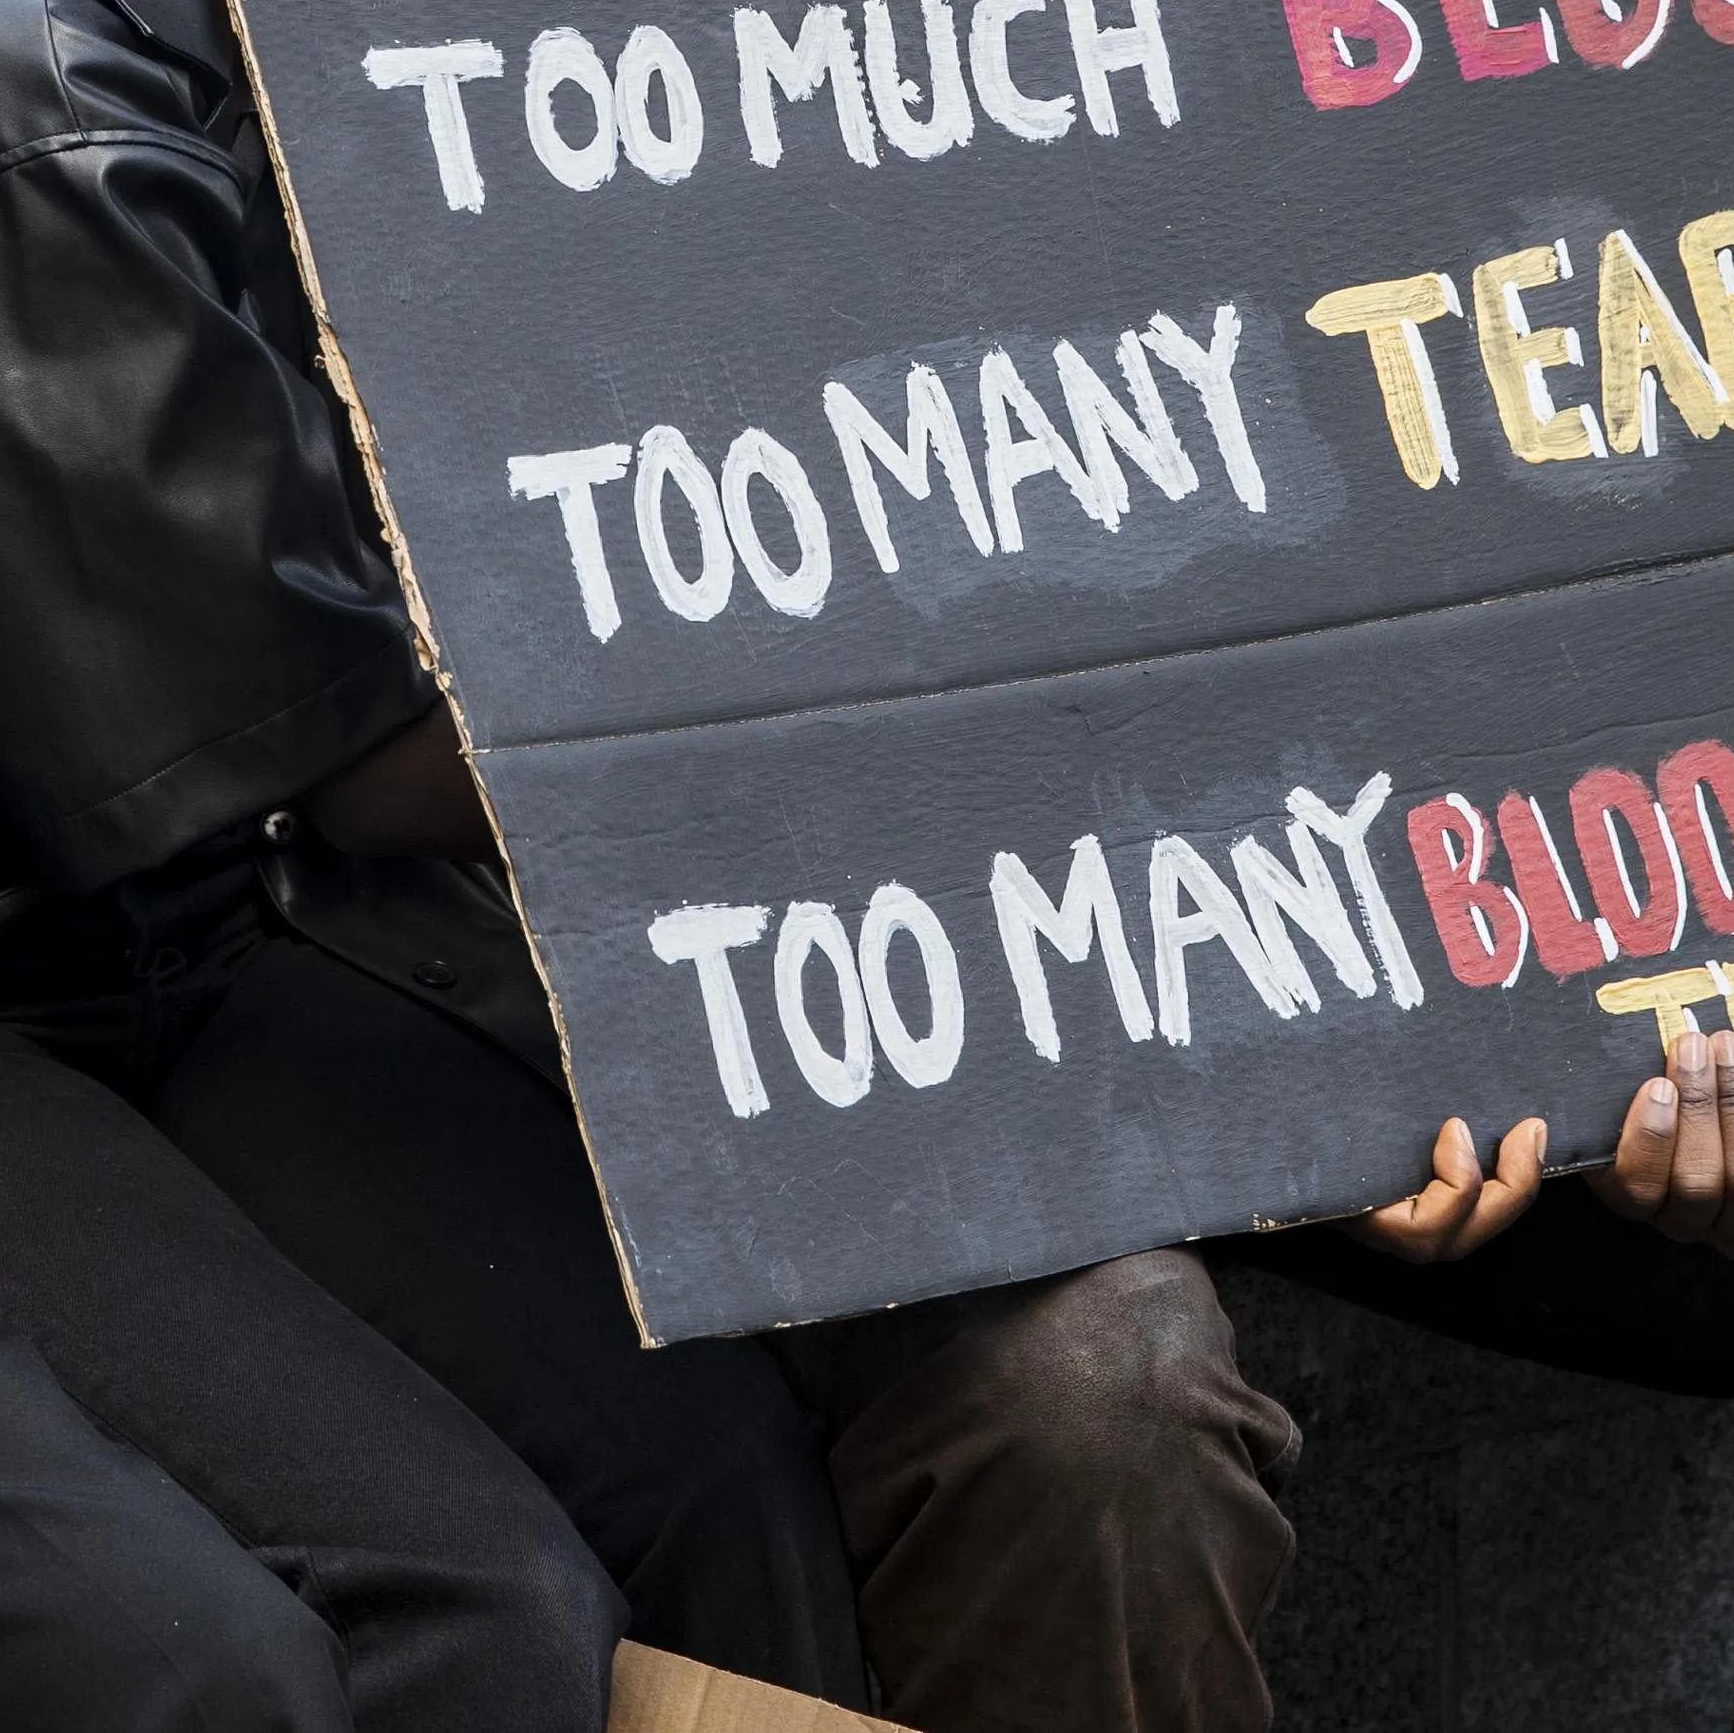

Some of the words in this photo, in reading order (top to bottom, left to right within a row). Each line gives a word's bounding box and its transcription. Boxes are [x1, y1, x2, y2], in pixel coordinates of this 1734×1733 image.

[364, 23, 705, 213] TOO
[508, 426, 831, 643] TOO
[823, 303, 1266, 574] MANY
[649, 883, 964, 1117] TOO
[991, 771, 1424, 1061] MANY
